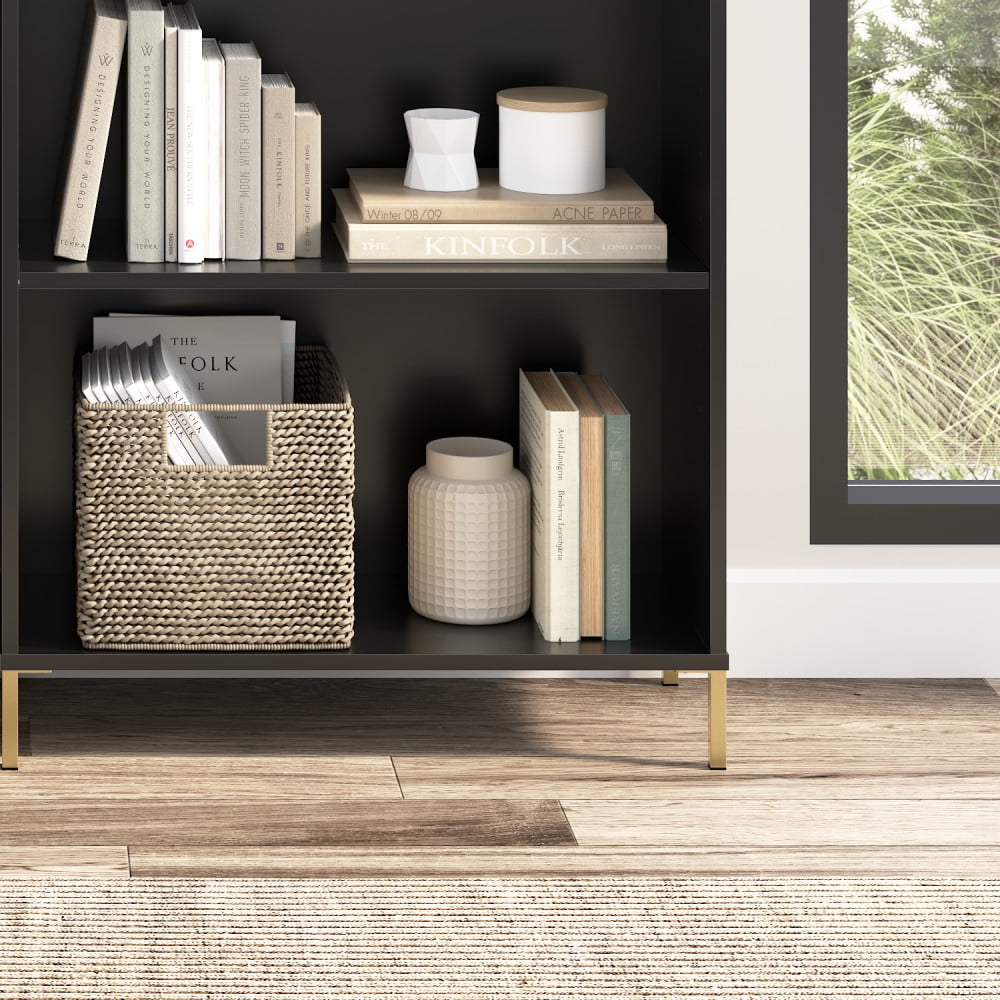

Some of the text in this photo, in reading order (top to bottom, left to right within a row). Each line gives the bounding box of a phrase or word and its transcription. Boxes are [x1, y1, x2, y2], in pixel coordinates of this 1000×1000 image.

[76, 74, 107, 209] DESIGNING YOUR WORLD
[143, 65, 151, 209] DESIGNING YOUR WORLD
[166, 107, 177, 173] JEAN PROUVÉ
[238, 75, 250, 199] MOON WITCH SPIDER KING
[275, 151, 283, 190] KINFOLK
[303, 162, 311, 185] FUTURE
[303, 186, 311, 202] AND
[366, 208, 442, 222] Winter 08/09
[552, 206, 642, 220] ACNE PAPER
[423, 236, 583, 256] KINFOLK
[170, 336, 198, 346] THE
[557, 427, 566, 450] Astrid
